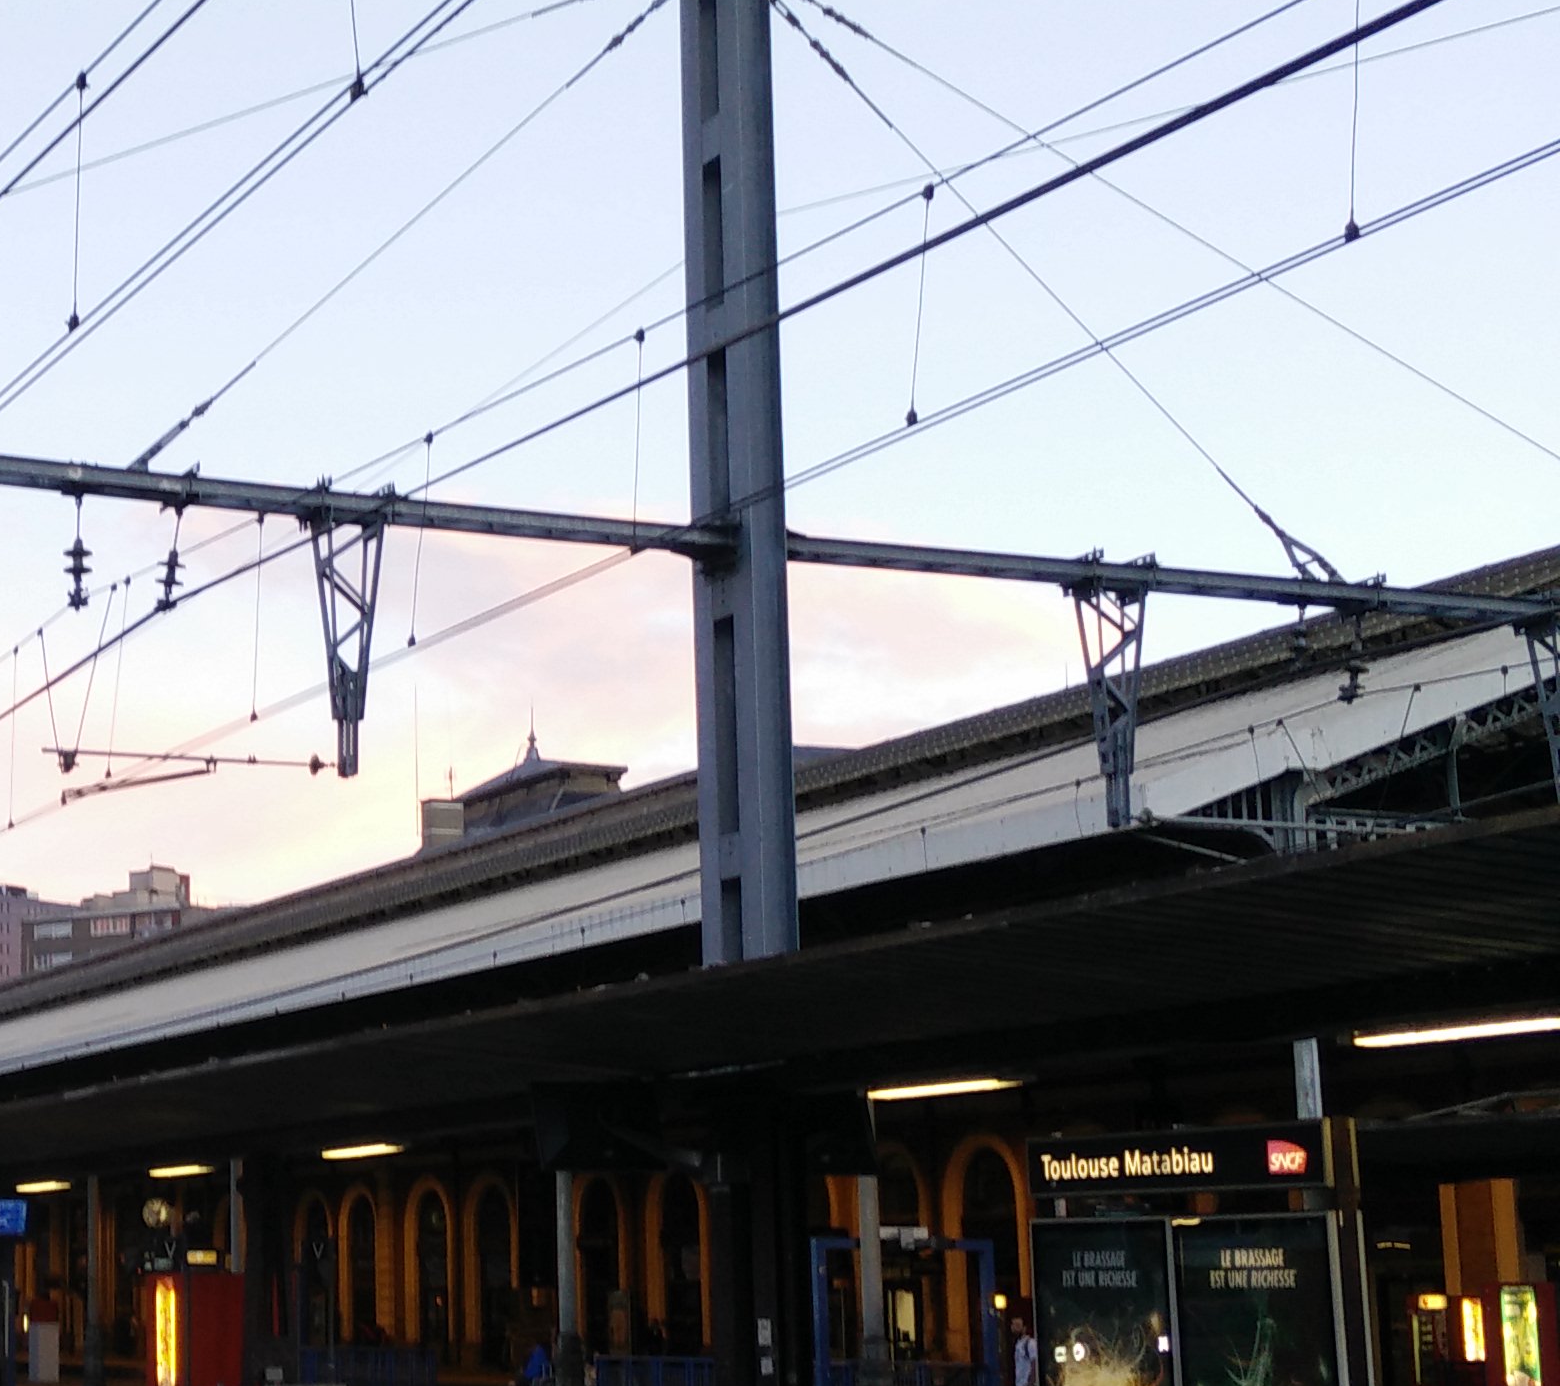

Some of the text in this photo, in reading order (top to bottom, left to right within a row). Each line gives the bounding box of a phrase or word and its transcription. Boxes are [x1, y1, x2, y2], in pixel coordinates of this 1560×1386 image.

[1041, 1147, 1214, 1181] Toulouse Matabiau
[1270, 1151, 1304, 1172] SNCF
[1083, 1249, 1126, 1269] BRASSAGE
[1220, 1247, 1285, 1269] LE BRASSAGE
[1062, 1269, 1138, 1289] EST UNE RICHESSE
[1209, 1269, 1297, 1289] EST UNE RICHESSE
